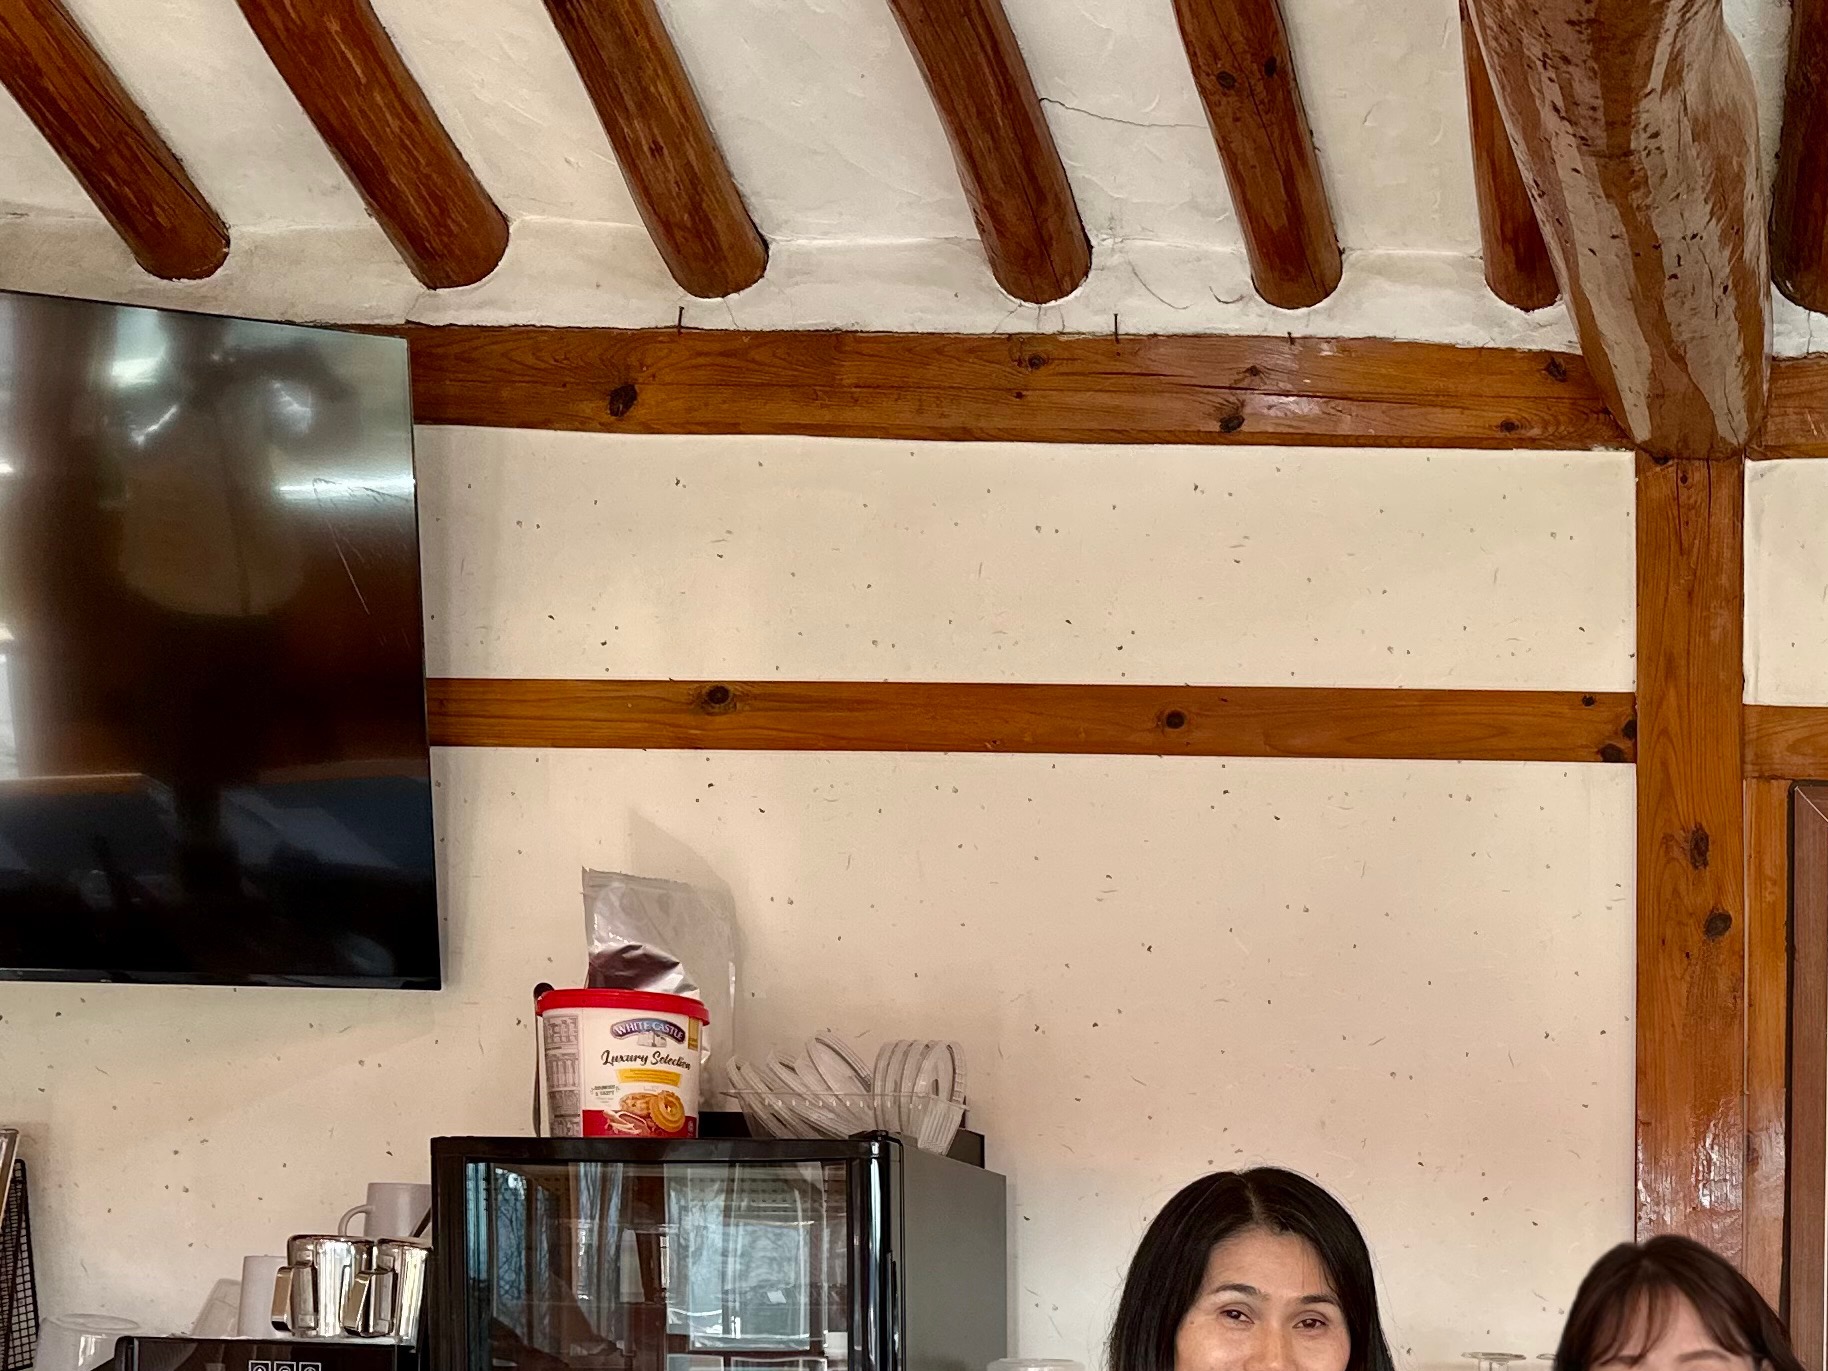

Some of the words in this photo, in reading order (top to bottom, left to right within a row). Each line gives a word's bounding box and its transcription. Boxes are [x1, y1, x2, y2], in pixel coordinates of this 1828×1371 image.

[613, 1020, 650, 1036] WHITE
[651, 1020, 685, 1041] CASTLE
[601, 1049, 649, 1067] Luxury
[651, 1050, 691, 1072] Selection
